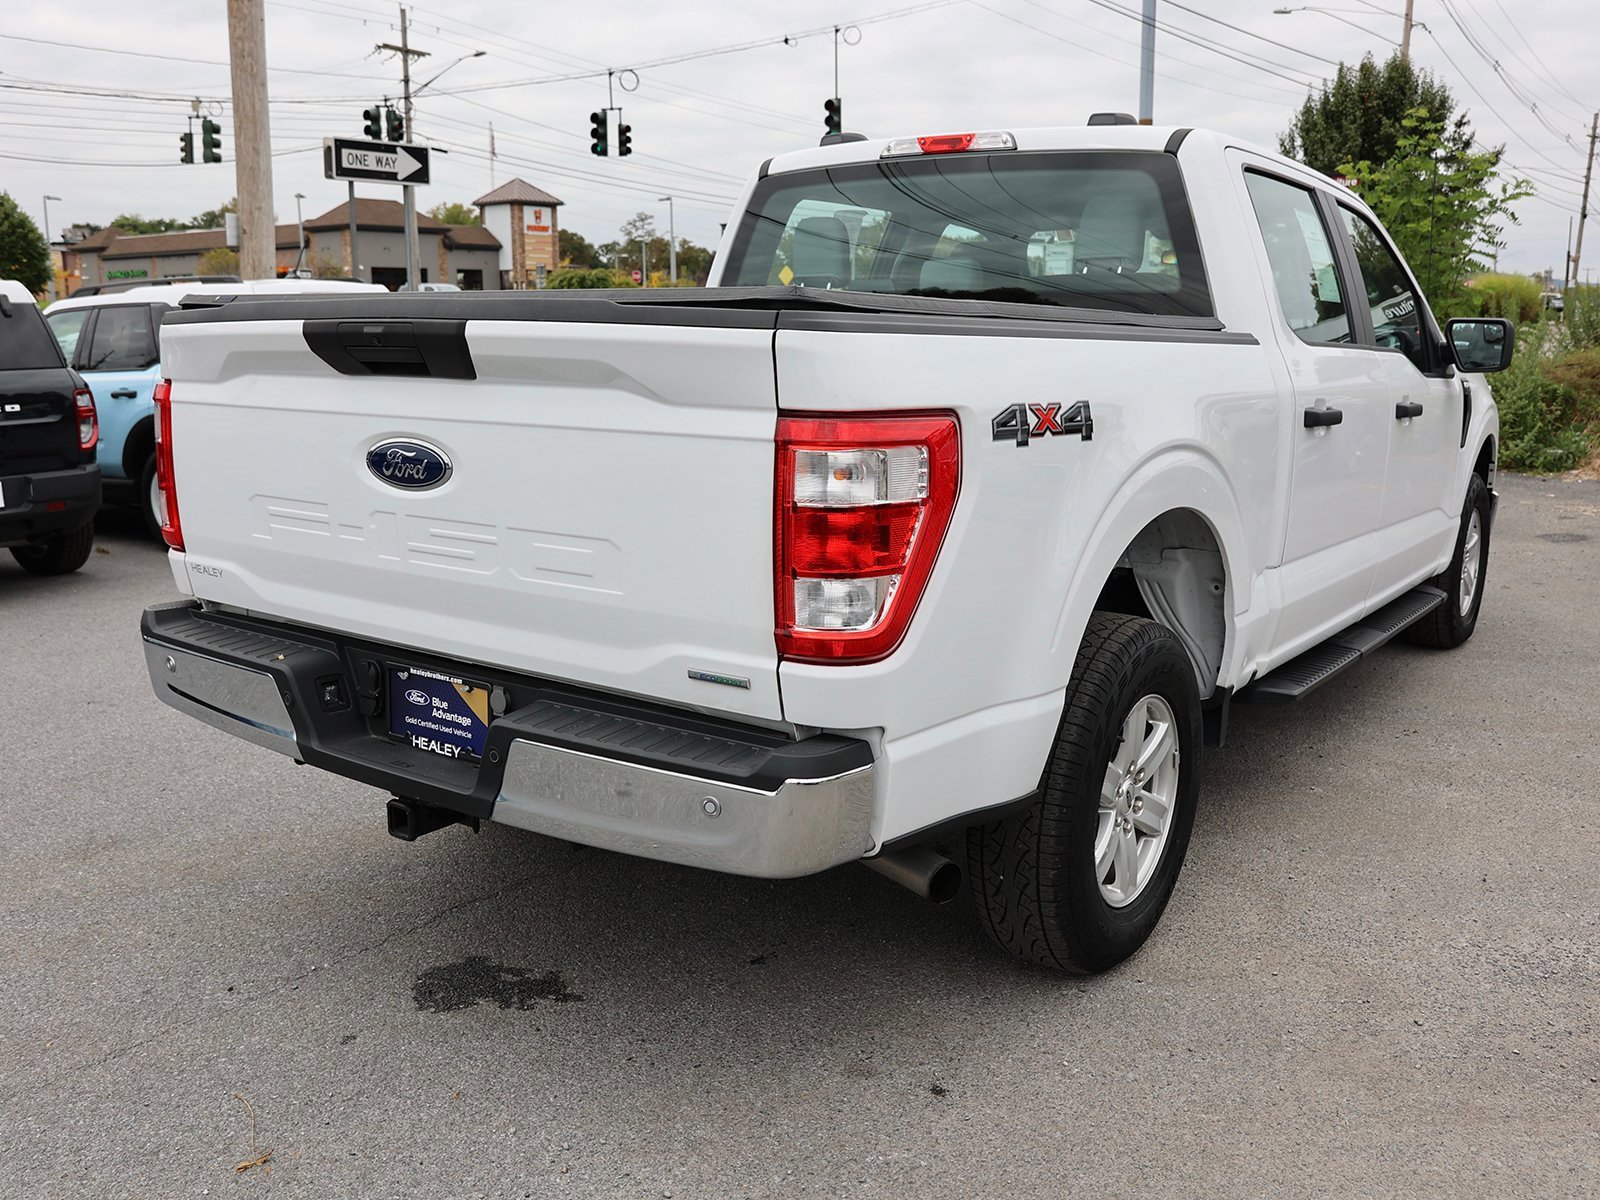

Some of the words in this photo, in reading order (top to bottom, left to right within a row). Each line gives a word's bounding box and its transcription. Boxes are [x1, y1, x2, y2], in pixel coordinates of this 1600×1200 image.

[347, 152, 369, 167] ONE
[375, 156, 397, 169] WAY
[382, 448, 428, 480] Ford
[190, 562, 223, 578] HEALEY
[410, 667, 463, 684] healeybrothers.com
[409, 691, 425, 704] Ford
[432, 697, 448, 709] Blue
[432, 708, 472, 726] Advantage
[405, 715, 417, 725] Gold
[417, 719, 439, 731] Certified
[439, 724, 453, 734] Used
[453, 728, 472, 739] Vehicle
[412, 735, 461, 758] HEALEY
